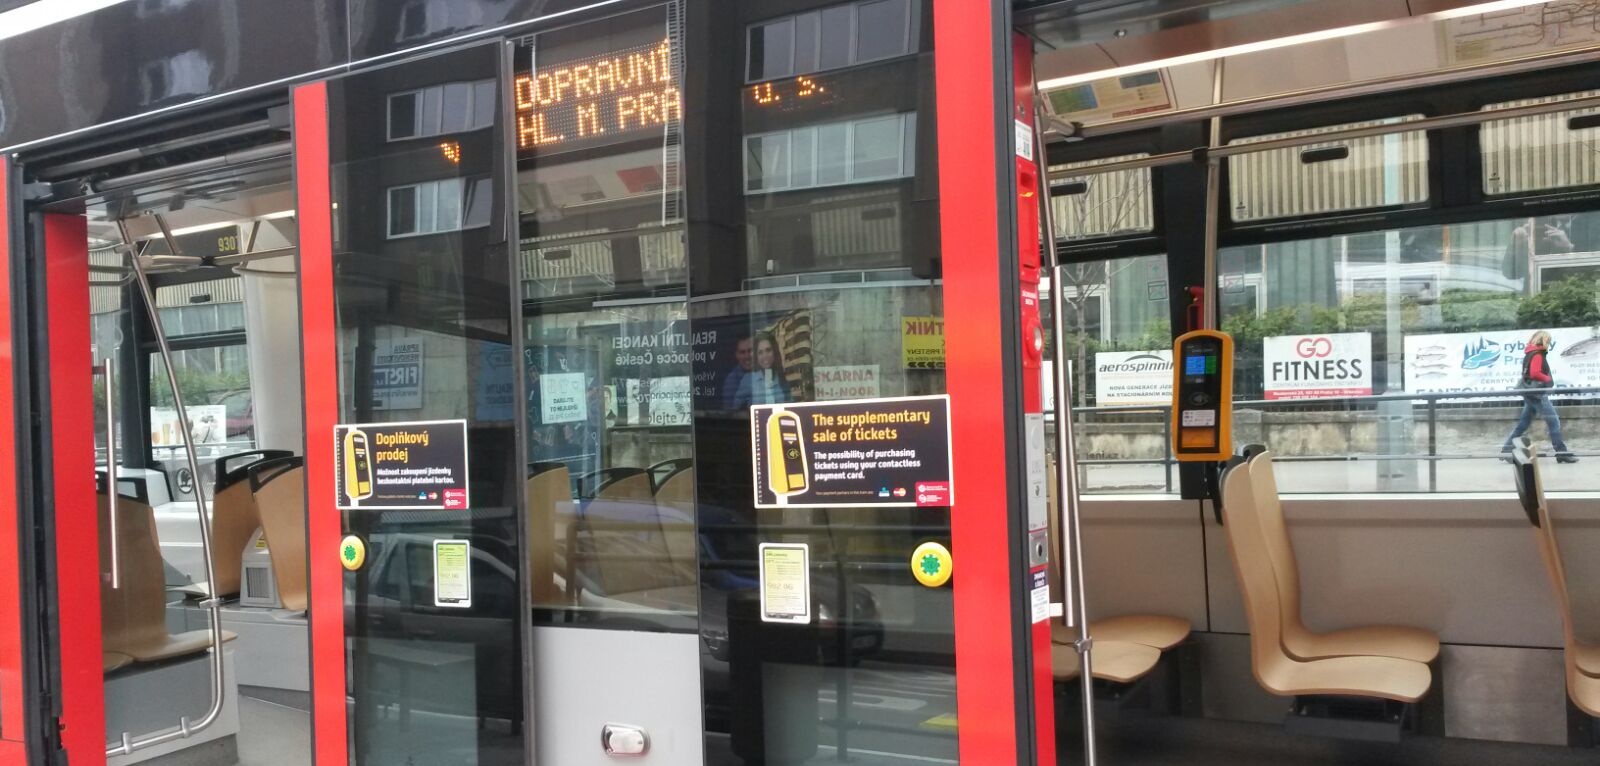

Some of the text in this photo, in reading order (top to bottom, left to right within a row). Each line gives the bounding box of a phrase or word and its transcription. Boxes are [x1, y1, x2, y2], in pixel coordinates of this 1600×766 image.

[515, 38, 671, 110] DOPRAVNÍ
[518, 87, 682, 147] HL. M. PRA
[218, 235, 238, 252] 930
[1296, 337, 1333, 359] GO
[1272, 358, 1363, 381] FITNESS
[812, 409, 931, 427] The supplementary
[376, 430, 430, 447] Doplňkový
[813, 427, 898, 442] sale of tickets
[376, 448, 409, 464] prodej
[814, 448, 916, 461] The possibility of purchasing
[814, 458, 922, 471] tickets using your contactless
[814, 470, 865, 482] payment card.
